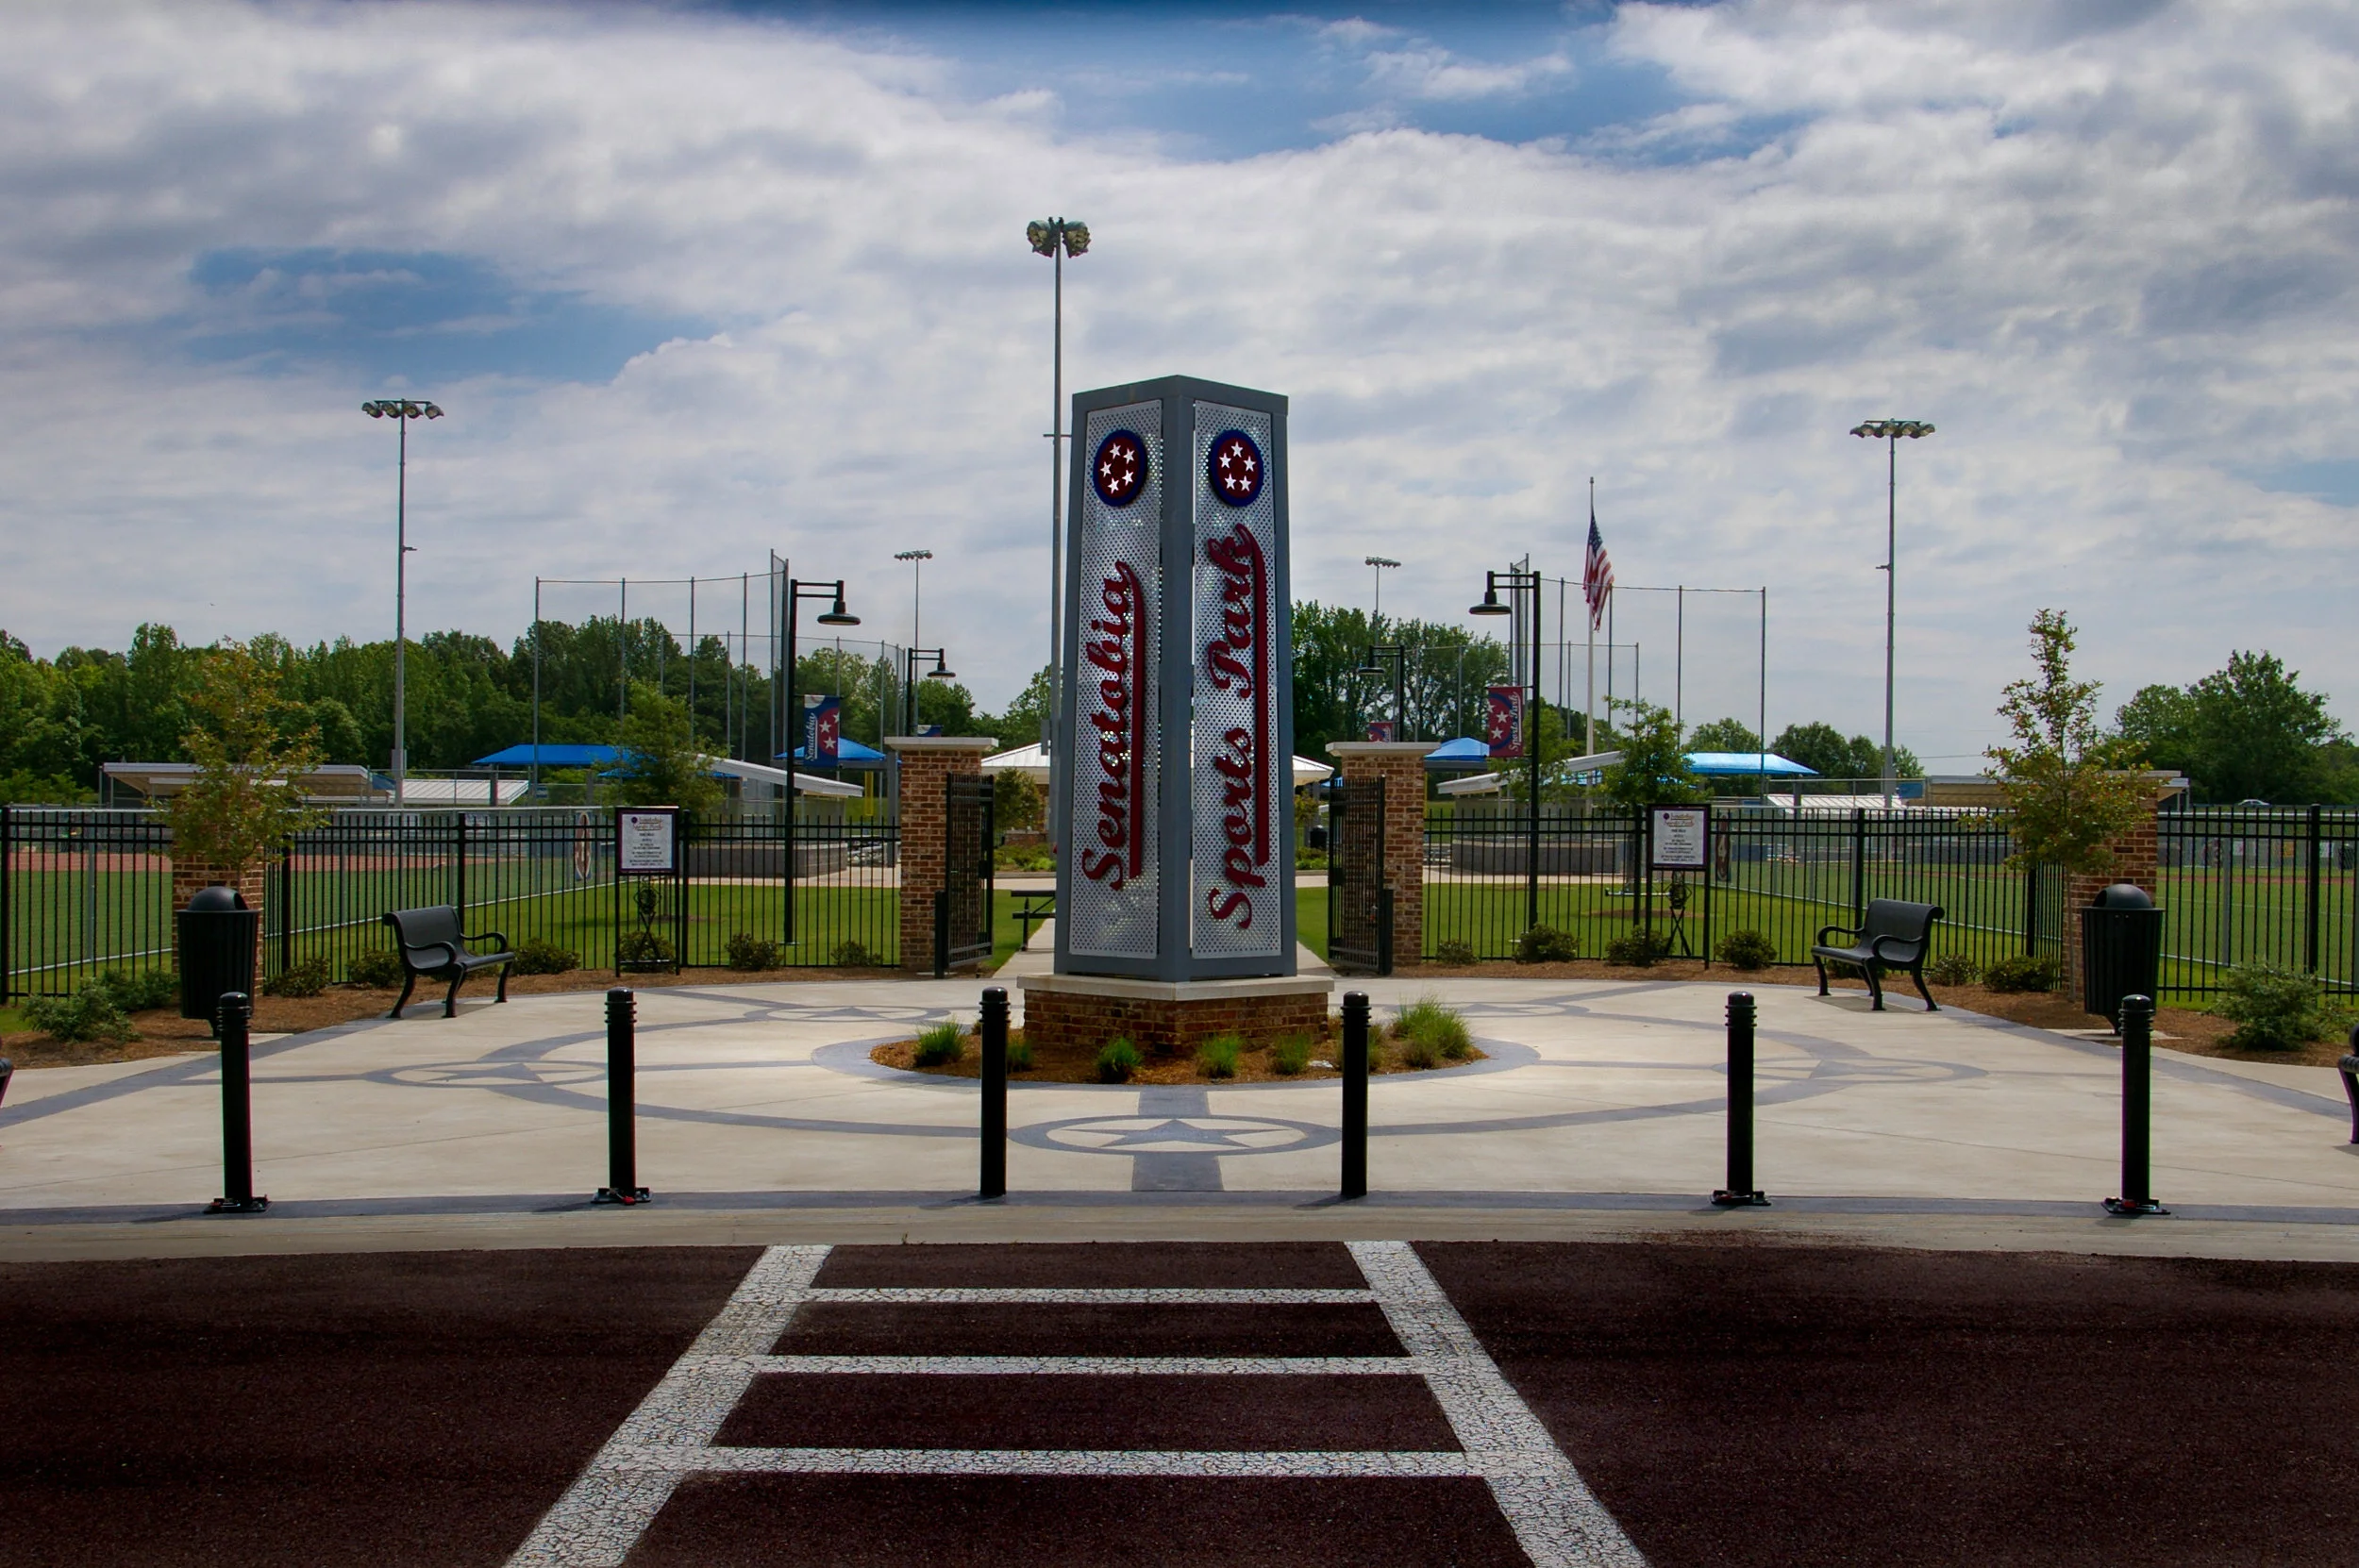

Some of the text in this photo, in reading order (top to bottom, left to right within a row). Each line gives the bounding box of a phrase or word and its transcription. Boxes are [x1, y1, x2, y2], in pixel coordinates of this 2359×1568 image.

[805, 712, 815, 761] Senatobia
[1081, 561, 1138, 892] Senatobia
[1207, 523, 1265, 930] Sports Park
[1509, 721, 1521, 752] Sports
